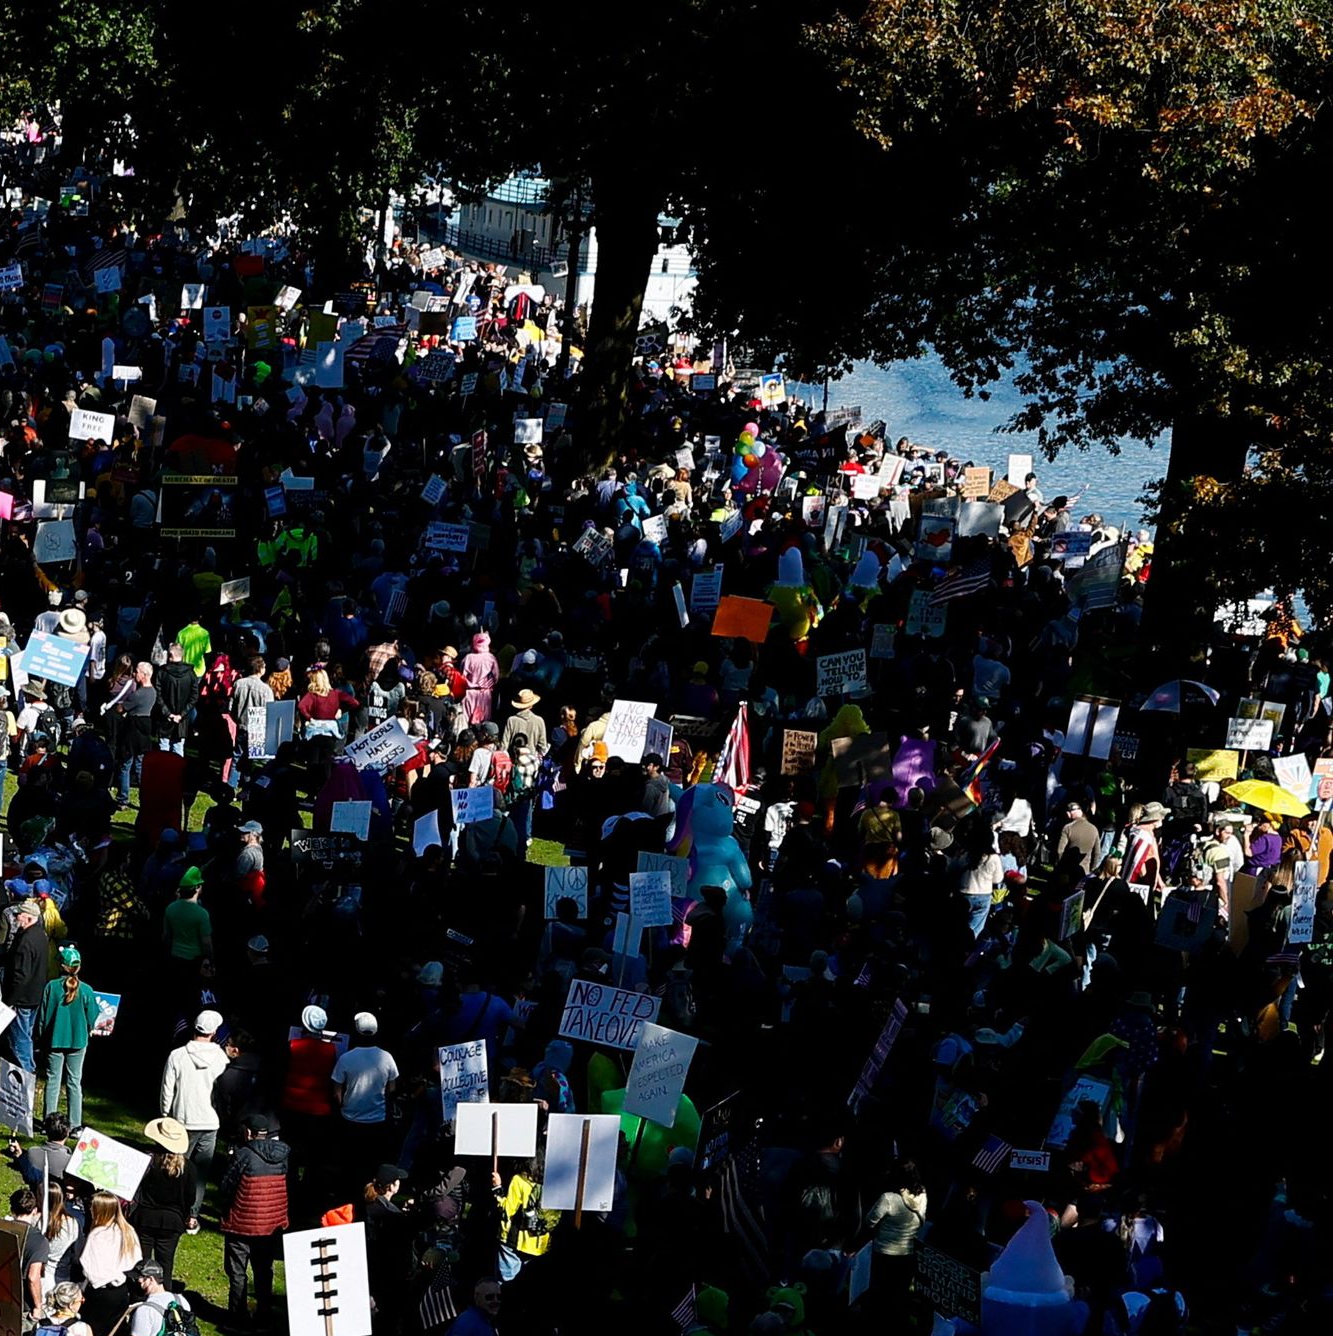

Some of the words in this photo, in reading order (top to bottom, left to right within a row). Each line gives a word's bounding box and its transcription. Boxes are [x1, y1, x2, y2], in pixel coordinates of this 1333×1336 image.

[819, 657, 841, 669] CAN
[842, 653, 864, 665] YOU
[825, 667, 847, 677] TELL
[848, 663, 865, 672] ME
[821, 675, 842, 686] HOW
[374, 696, 383, 707] NO
[628, 704, 646, 714] NO
[369, 723, 395, 743] GIRLS
[610, 723, 648, 737] SINCE
[612, 735, 638, 748] 1776
[368, 741, 392, 759] HATE
[571, 982, 603, 1007] NO
[610, 989, 654, 1019] FED
